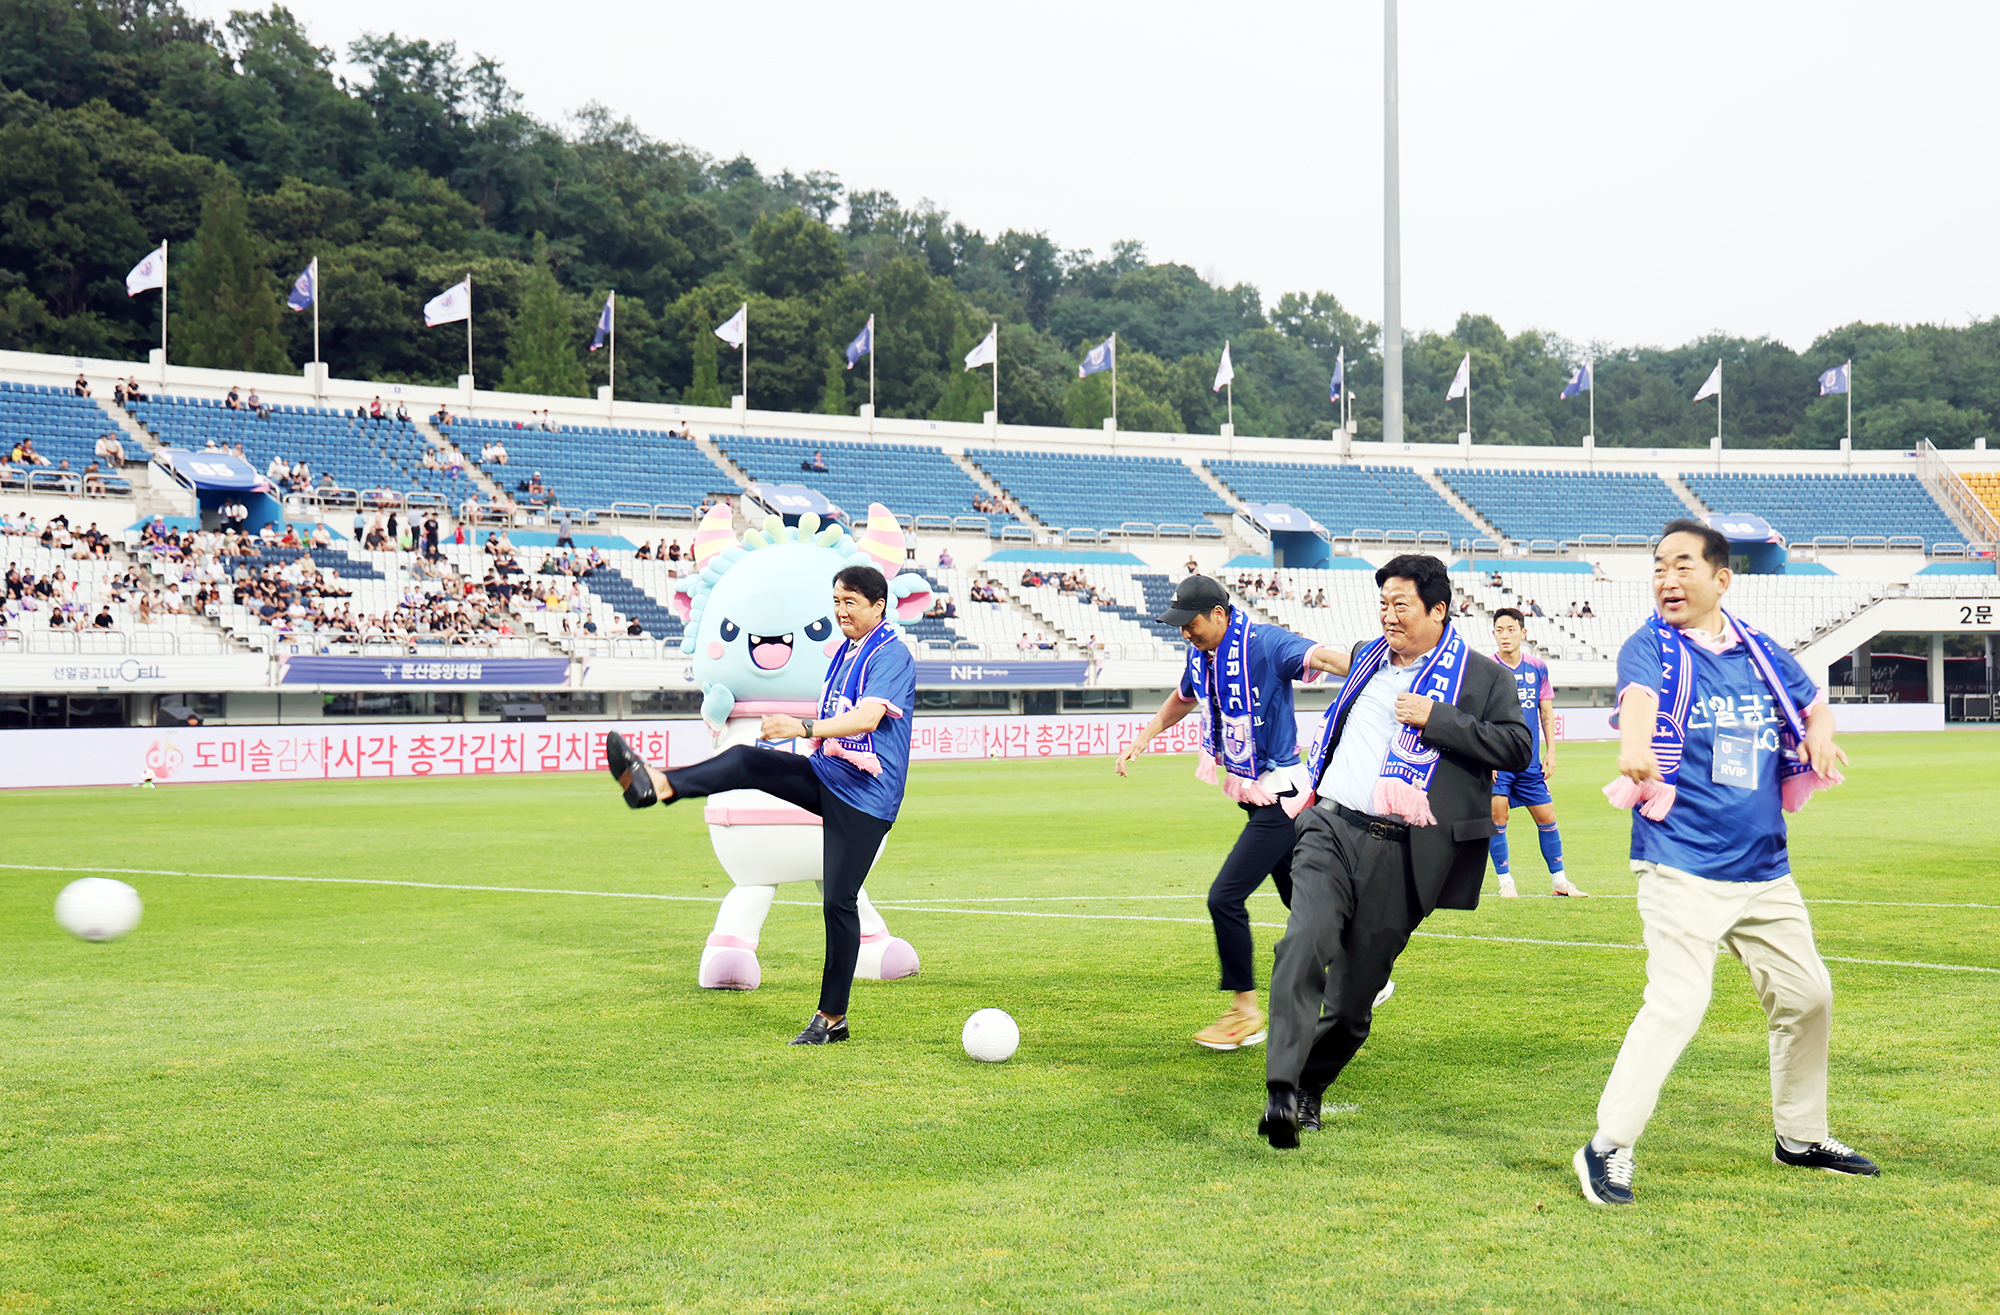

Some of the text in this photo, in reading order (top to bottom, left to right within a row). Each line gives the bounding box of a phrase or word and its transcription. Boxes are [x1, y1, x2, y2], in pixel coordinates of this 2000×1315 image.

[1960, 605, 1993, 624] 2문
[951, 665, 983, 680] NH
[1227, 683, 1243, 710] FC
[1036, 722, 1109, 756] 총각김치
[408, 732, 525, 776] 총각김치
[1720, 763, 1748, 778] RVIP
